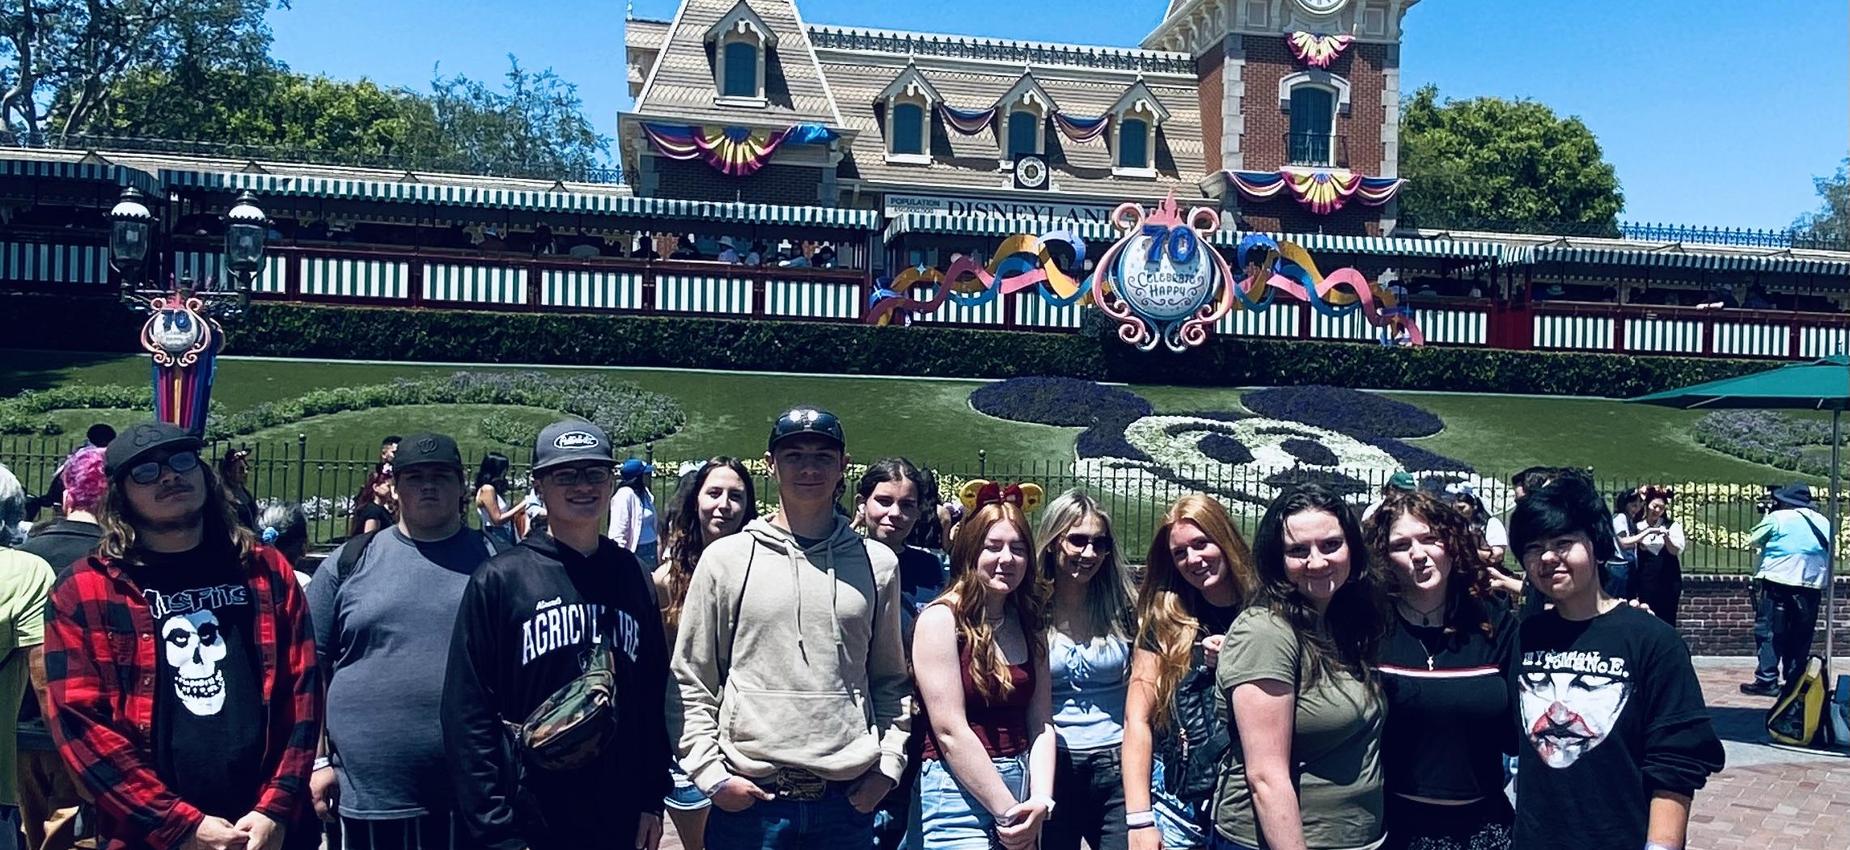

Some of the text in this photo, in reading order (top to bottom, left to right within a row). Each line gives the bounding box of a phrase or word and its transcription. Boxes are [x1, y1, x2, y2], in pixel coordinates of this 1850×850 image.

[890, 197, 940, 207] POPULATION
[1141, 224, 1198, 265] 70
[1149, 284, 1187, 298] HAPPY
[522, 603, 639, 665] AGRICULURE
